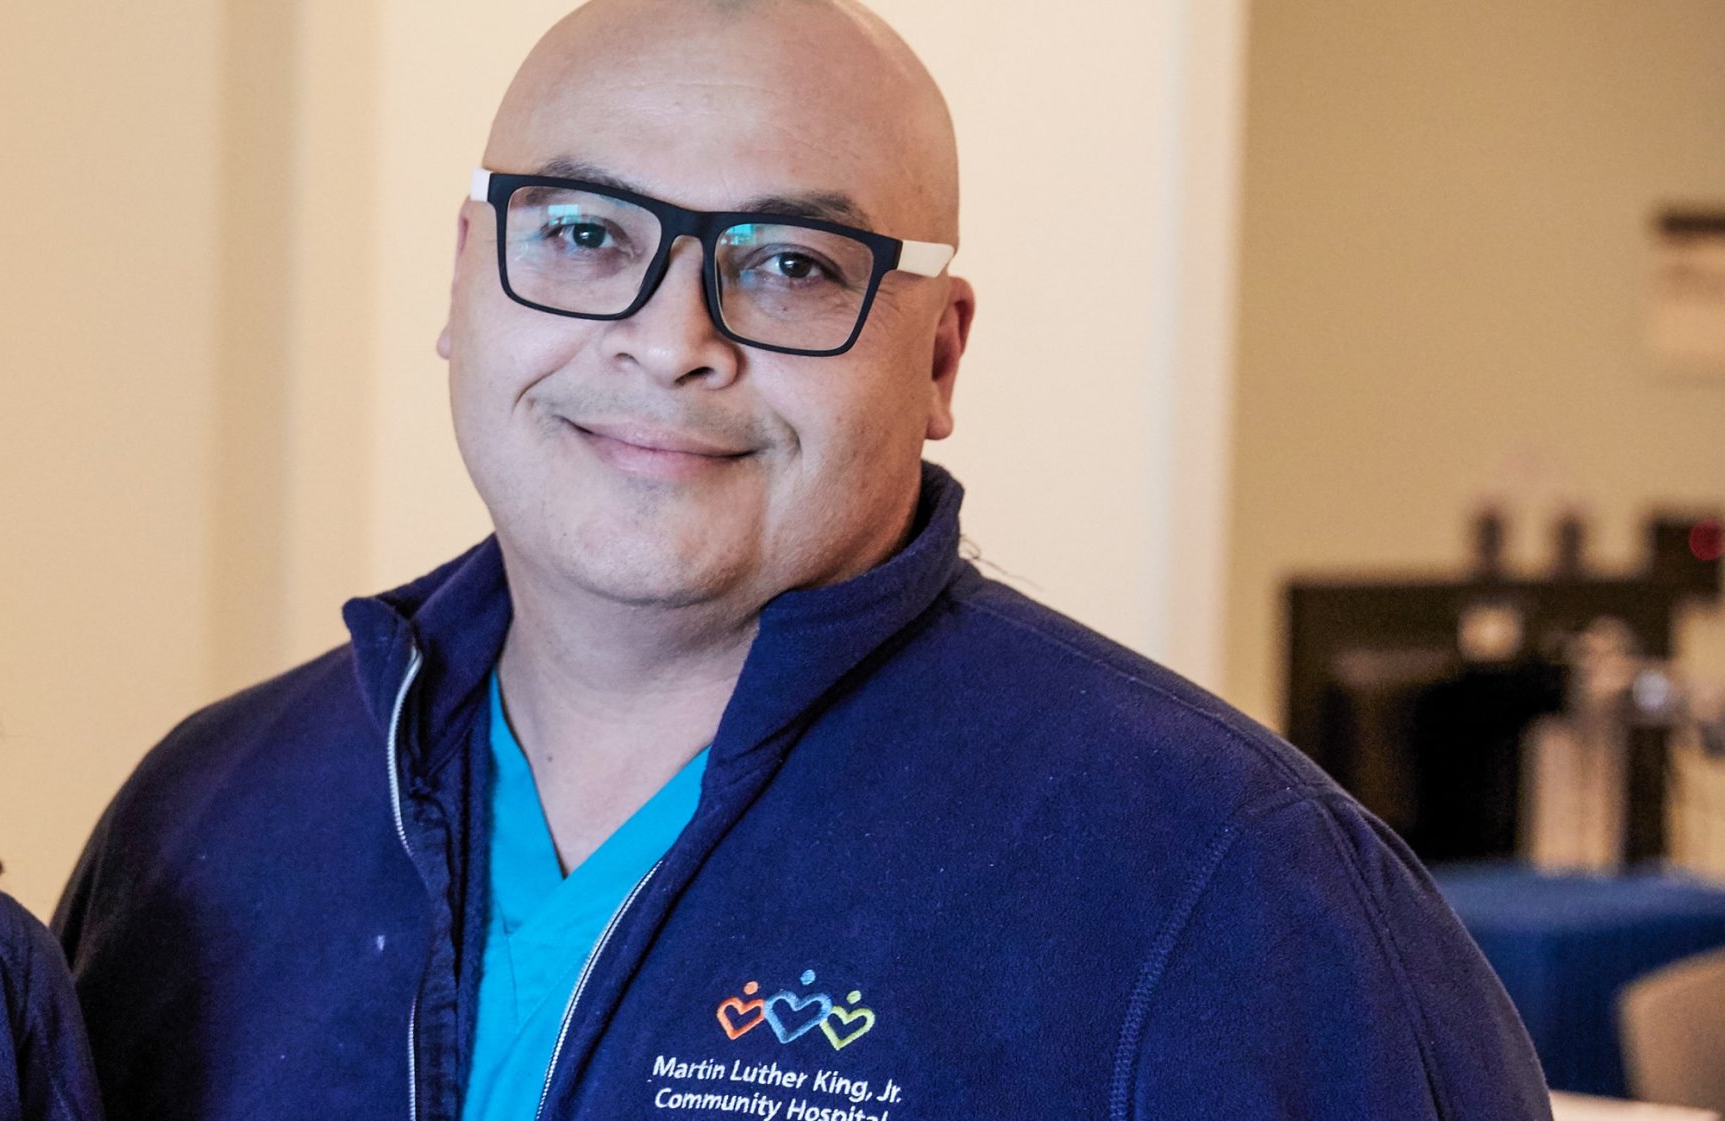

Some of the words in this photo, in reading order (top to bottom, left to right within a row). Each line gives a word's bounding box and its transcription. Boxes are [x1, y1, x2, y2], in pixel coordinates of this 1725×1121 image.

[653, 1055, 726, 1080] Martin
[730, 1060, 808, 1089] Luther
[813, 1069, 873, 1103] King,
[876, 1079, 902, 1103] Jr.
[655, 1087, 783, 1121] Community
